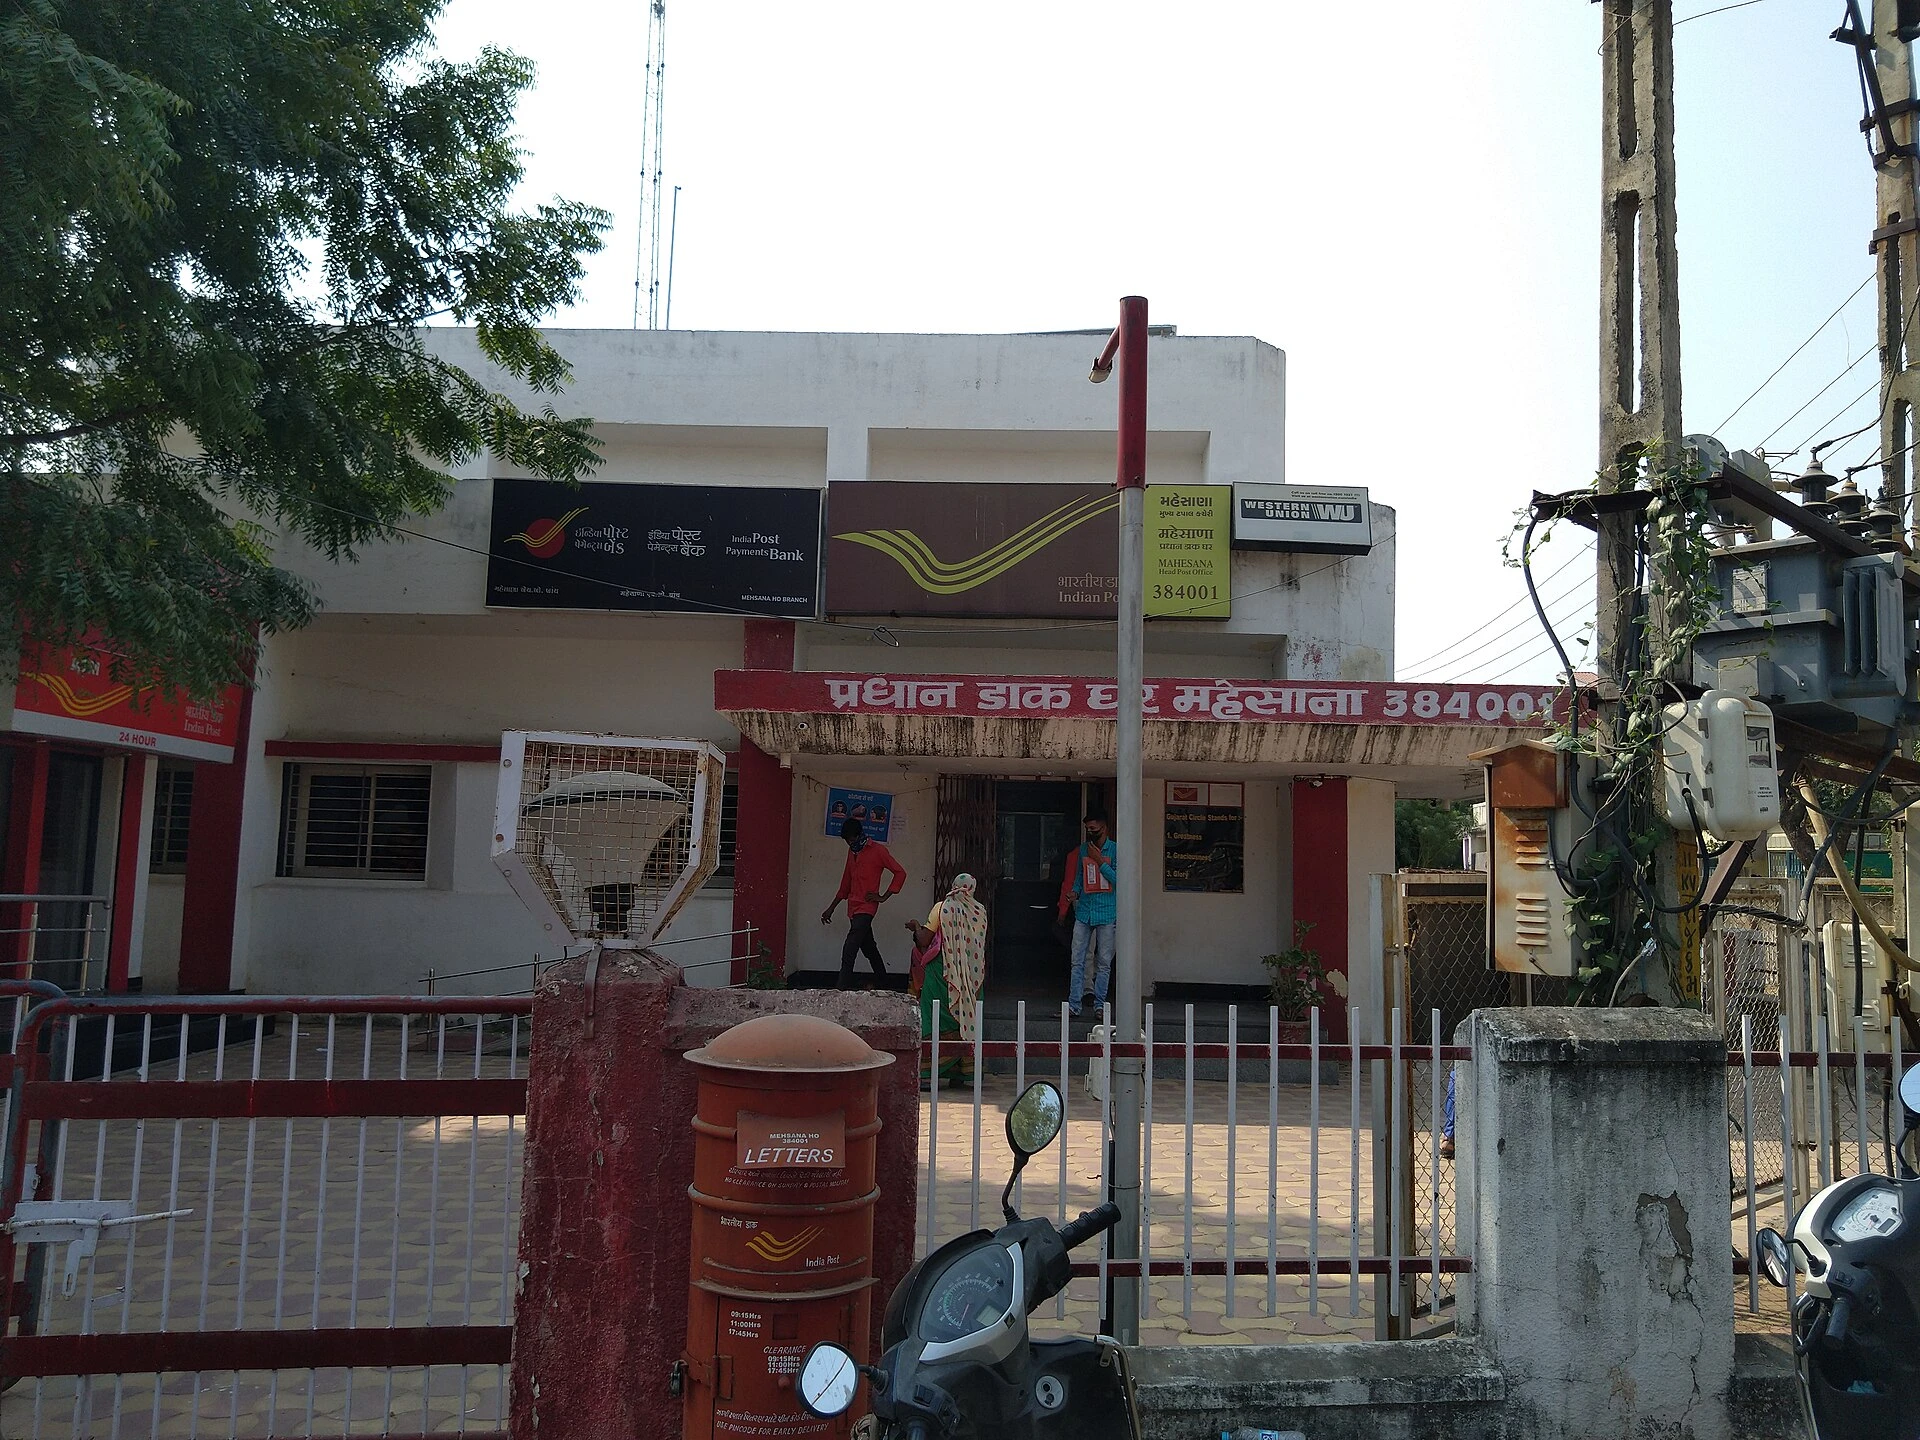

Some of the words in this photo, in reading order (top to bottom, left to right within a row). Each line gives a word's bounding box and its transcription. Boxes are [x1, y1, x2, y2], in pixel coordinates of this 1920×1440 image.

[1160, 492, 1213, 508] મહેસાણા
[1244, 500, 1310, 511] WESTERN
[1265, 509, 1310, 519] UNION
[1316, 503, 1355, 521] WU
[603, 524, 629, 539] પોસ્ટ
[647, 529, 671, 540] इंडिया
[671, 526, 702, 541] पोस्ट
[731, 534, 752, 543] India
[752, 532, 780, 545] Post
[1158, 524, 1215, 540] महेसाणा
[679, 540, 707, 557] बैंक
[725, 546, 769, 557] Payments
[769, 548, 804, 561] Bank
[1158, 559, 1213, 568] MAHESANA
[1058, 572, 1104, 588] भारतीय
[1104, 576, 1118, 588] डा
[741, 594, 771, 602] MEHSANA
[1059, 591, 1101, 603] Indian
[1103, 591, 1119, 603] Po
[1152, 584, 1219, 600] 384001
[823, 676, 964, 709] प्रधान
[976, 681, 1072, 711] डाक
[1174, 679, 1369, 720] महेसाना
[1383, 689, 1555, 721] 384001
[184, 719, 205, 734] India
[205, 723, 222, 737] Post
[119, 731, 130, 743] 24
[132, 734, 157, 747] HOUR
[1173, 870, 1189, 880] Glory
[1681, 873, 1697, 892] KV
[744, 1147, 834, 1164] LETTERS
[720, 1215, 743, 1228] भारतीय
[805, 1256, 825, 1267] India
[826, 1254, 840, 1265] Post
[731, 1310, 762, 1320] 09:15Hrs
[730, 1320, 761, 1328] 11:00Hrs
[728, 1328, 759, 1338] 17:45Hrs
[763, 1345, 807, 1354] CLEARANCE
[716, 1420, 728, 1430] USE
[728, 1423, 756, 1435] PINCODE
[758, 1427, 772, 1436] FOR
[773, 1426, 796, 1436] EARLY
[797, 1422, 830, 1435] DELIVERY
